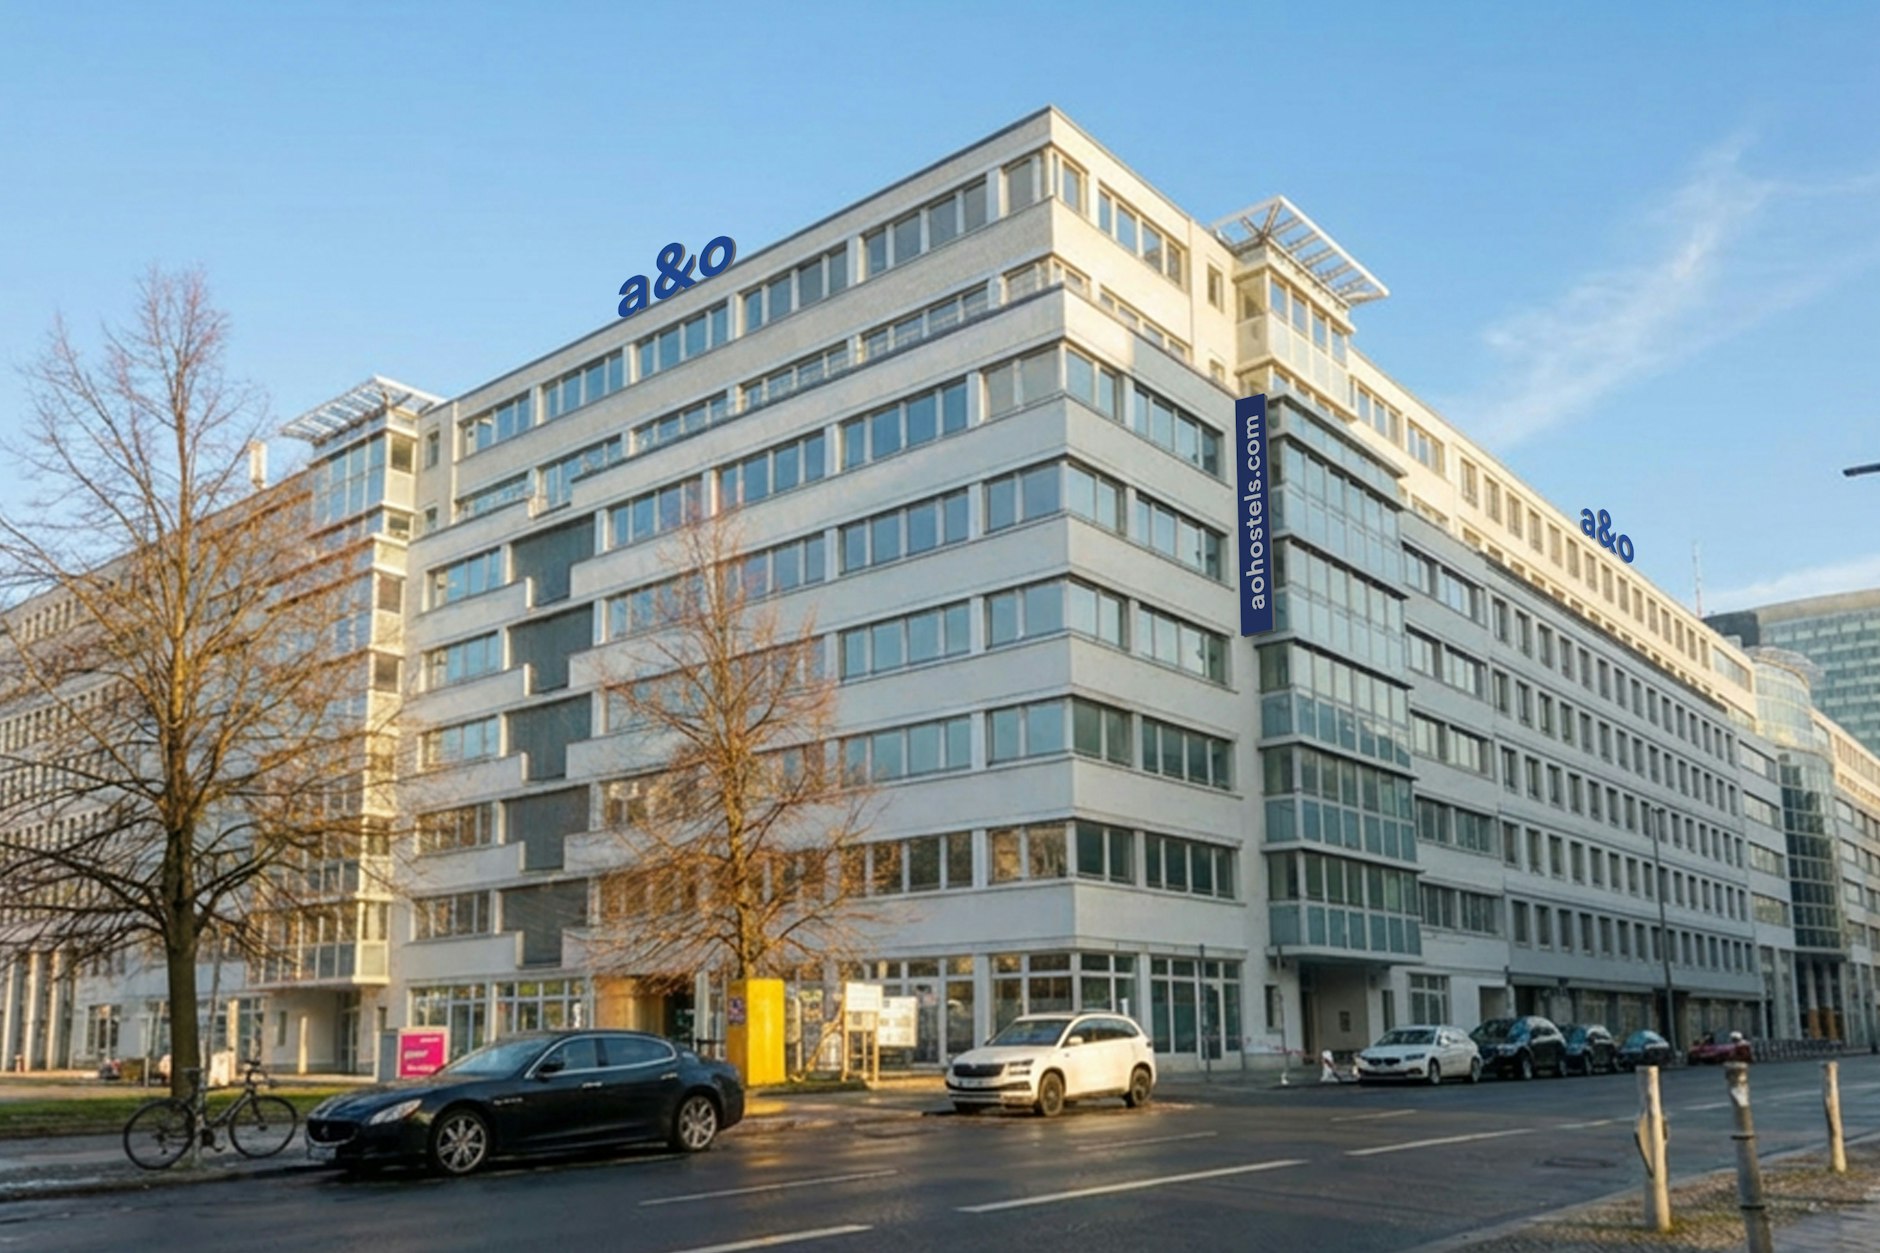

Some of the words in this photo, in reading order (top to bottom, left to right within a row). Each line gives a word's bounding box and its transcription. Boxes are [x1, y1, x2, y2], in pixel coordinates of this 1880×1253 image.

[618, 236, 736, 317] a&o
[1243, 414, 1266, 610] aohostels.com
[1580, 508, 1634, 563] a&o
